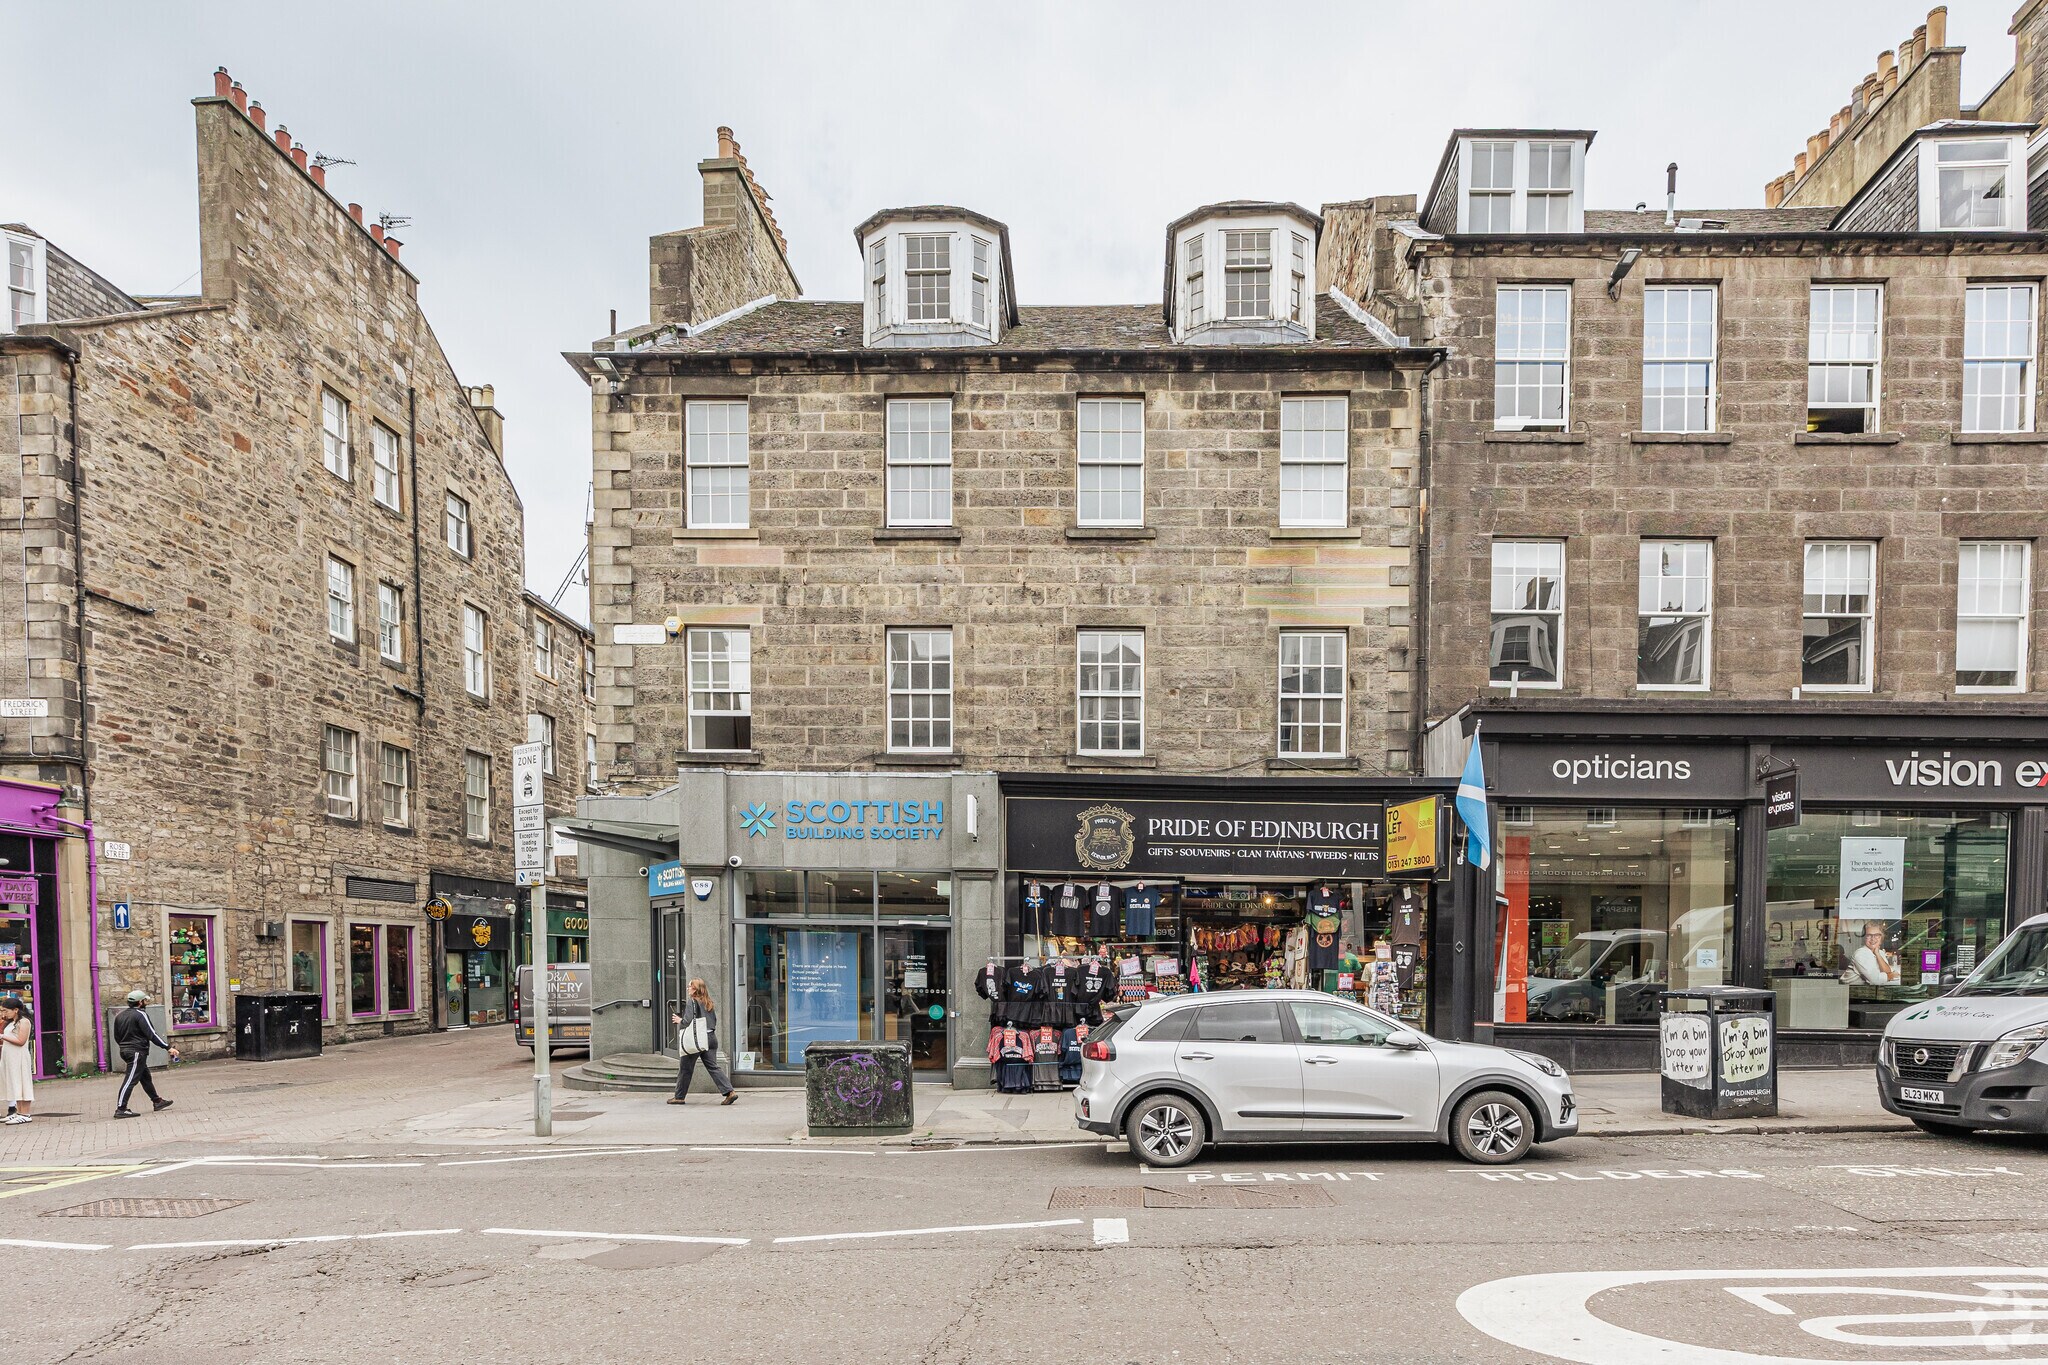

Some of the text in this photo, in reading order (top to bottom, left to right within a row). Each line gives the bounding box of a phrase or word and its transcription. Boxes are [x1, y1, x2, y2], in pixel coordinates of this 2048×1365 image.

[3, 700, 45, 708] FREDERICK
[10, 708, 37, 716] STREET
[514, 746, 541, 755] PEDESTRIAN
[518, 755, 537, 767] ZONE
[1552, 753, 1691, 785] opticians
[1885, 750, 2002, 786] vision
[1771, 790, 1791, 803] vision
[785, 800, 944, 824] SCOTTISH
[1767, 801, 1795, 815] express
[1388, 810, 1399, 823] TO
[785, 826, 944, 840] BUILDING SOCIETY
[1148, 818, 1379, 841] PRIDE OF EDINBURGH
[1388, 822, 1402, 835] LET
[109, 842, 125, 850] ROSE
[106, 850, 129, 858] STREET
[1147, 847, 1173, 856] GIFTS
[1179, 848, 1231, 858] SOUVENIRS
[1237, 850, 1262, 858] CLAN
[1265, 850, 1305, 859] TARTANS
[1309, 851, 1347, 860] TWEEDS
[1353, 852, 1379, 861] KILTS
[1388, 855, 1430, 869] 0131 247 3800
[5, 883, 33, 891] DAYS
[3, 892, 33, 901] WEEK
[564, 916, 589, 930] GOOD
[547, 982, 583, 992] INERY
[1663, 1024, 1706, 1043] I'm a bin
[1722, 1023, 1768, 1046] I'm a bin
[1666, 1047, 1707, 1060] Drop your
[1723, 1046, 1768, 1061] Drop your
[1672, 1061, 1704, 1072] litter in
[1731, 1060, 1765, 1076] litter in
[1720, 1088, 1771, 1097] #OurEDINBURGH
[1904, 1088, 1940, 1102] SL23 MKX
[1187, 1171, 1384, 1183] PERMIT
[1477, 1168, 1765, 1182] HOLDERS
[1847, 1166, 2025, 1177] ONLY
